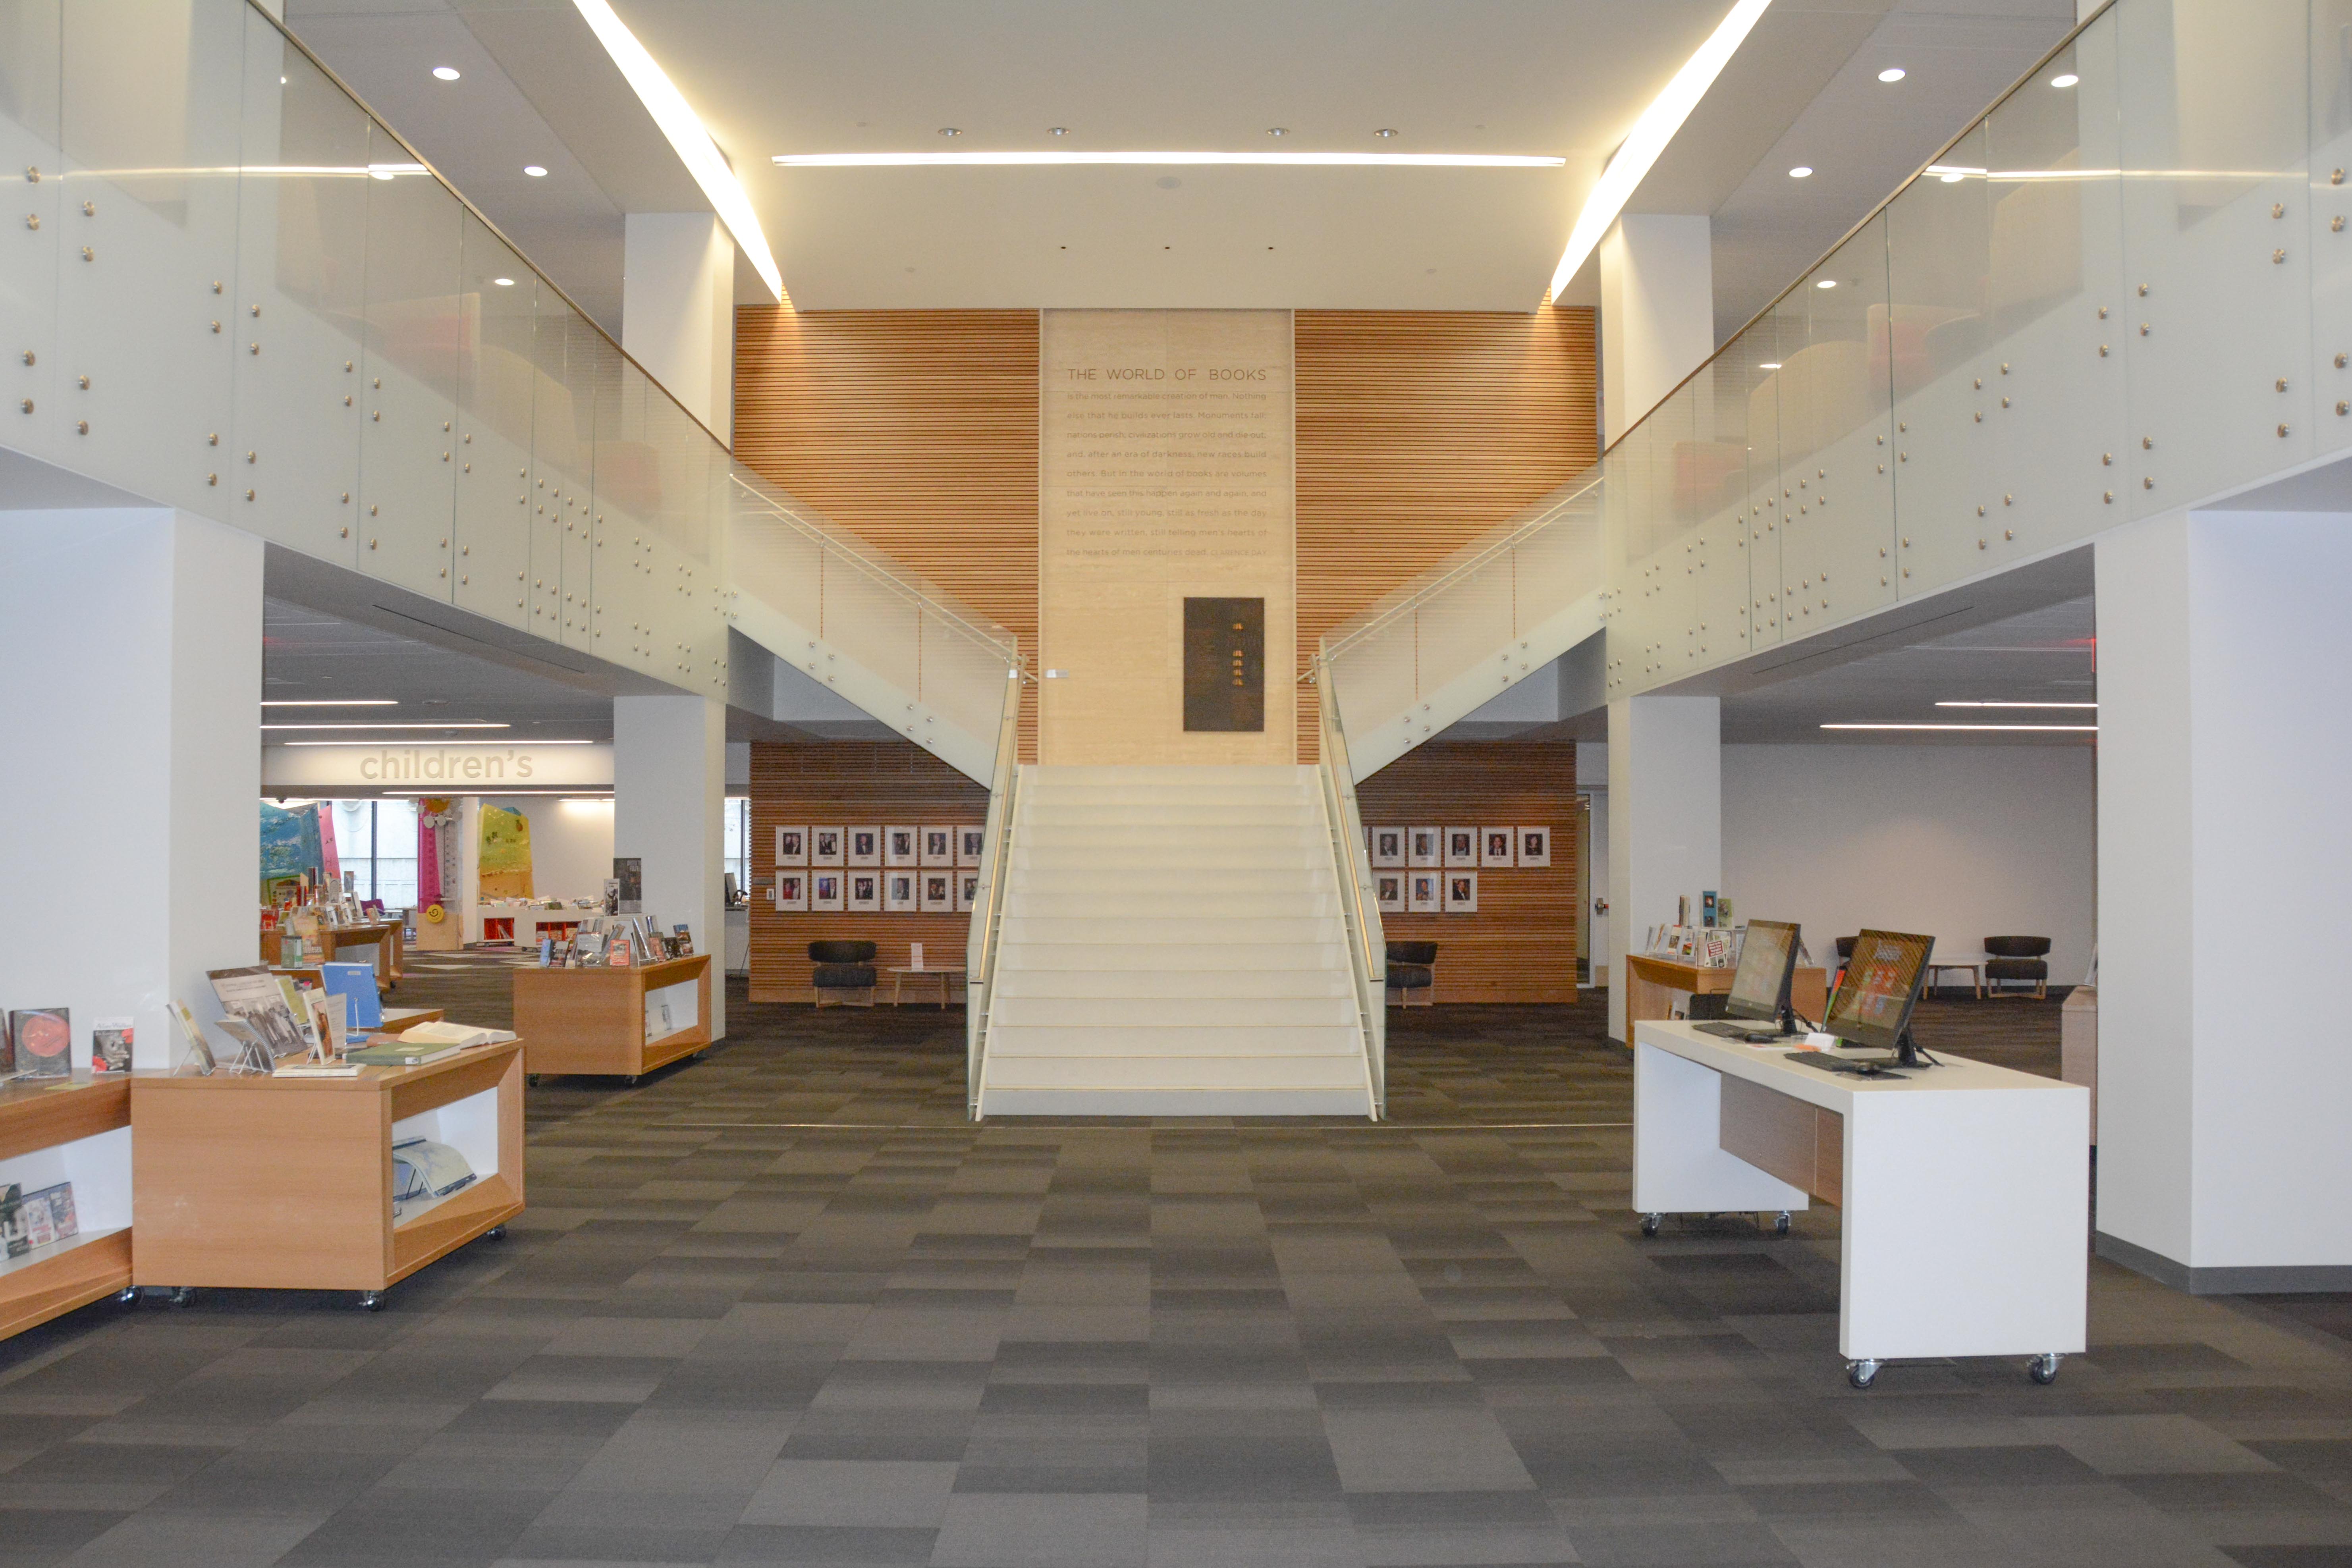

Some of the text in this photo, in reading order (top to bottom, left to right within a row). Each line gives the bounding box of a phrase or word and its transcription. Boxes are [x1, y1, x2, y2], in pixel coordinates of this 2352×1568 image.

[1068, 369, 1266, 380] THE WORLD OF BOOKS
[1233, 392, 1266, 401] Nothing
[360, 749, 533, 779] children's
